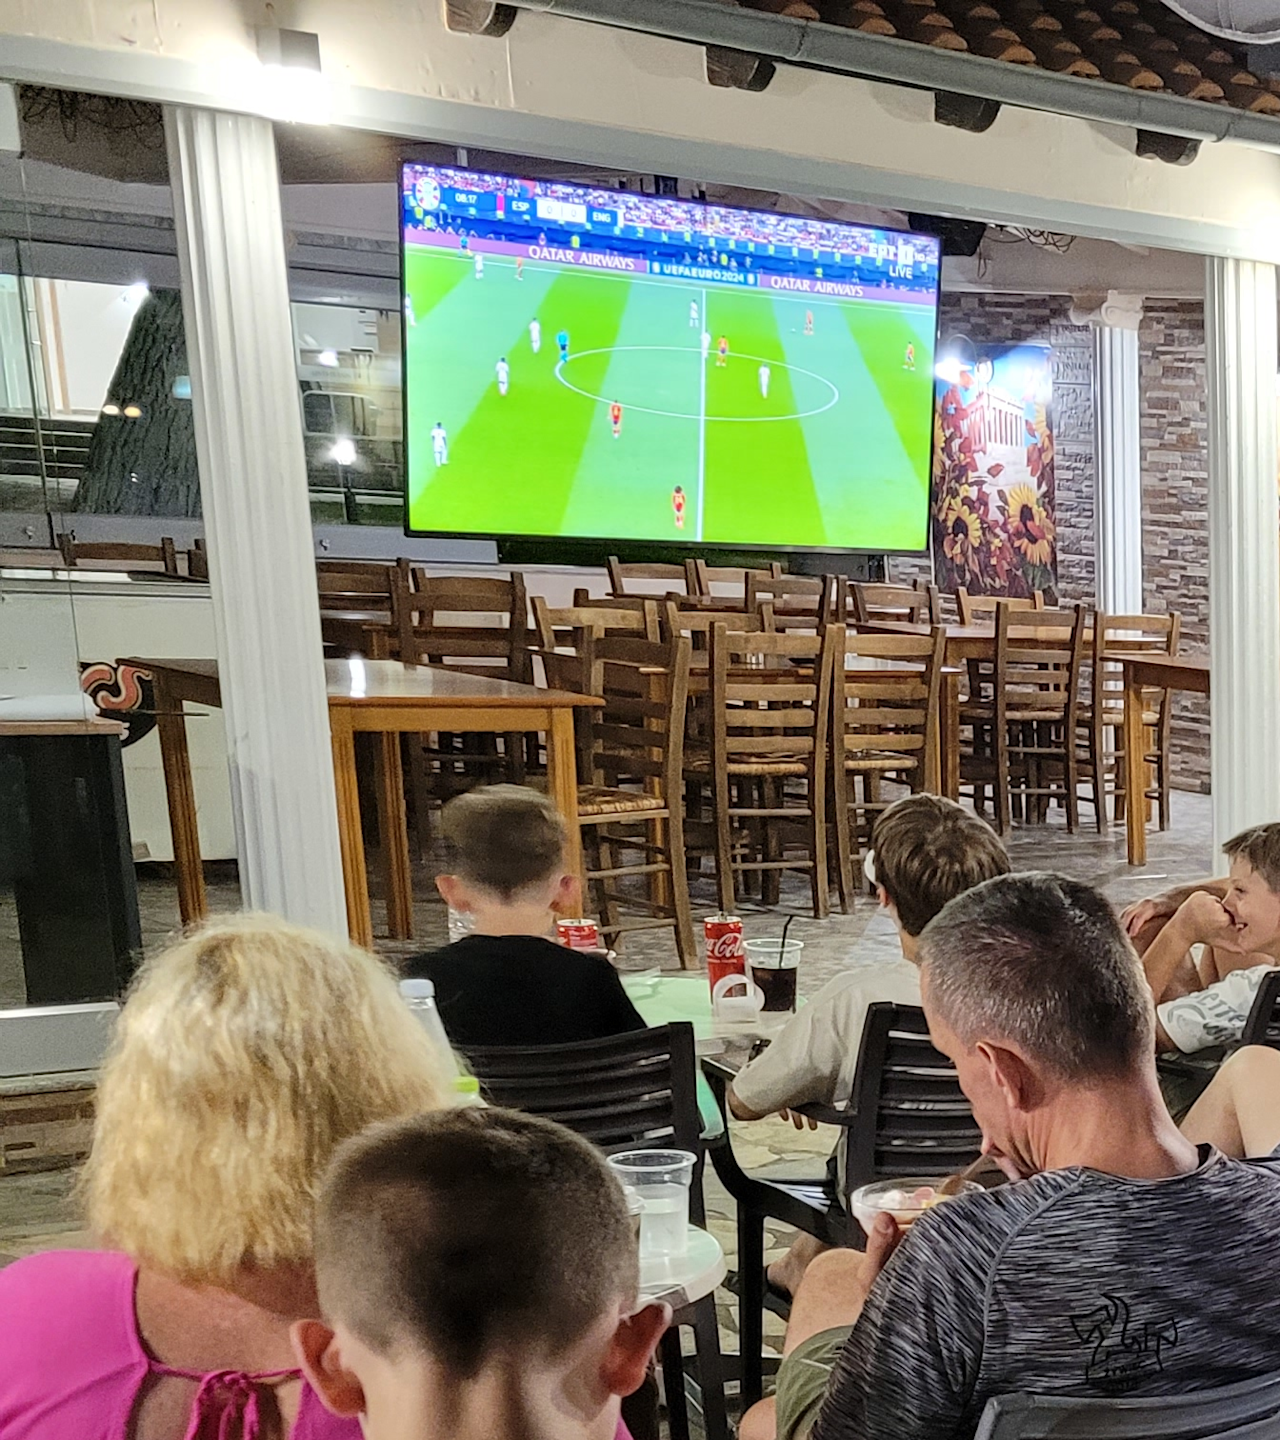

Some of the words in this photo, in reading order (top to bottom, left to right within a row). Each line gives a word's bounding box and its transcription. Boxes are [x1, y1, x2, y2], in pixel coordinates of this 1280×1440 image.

[511, 200, 530, 212] ESP
[592, 210, 611, 223] ENG
[528, 244, 575, 263] QATAR
[578, 251, 635, 270] AIRWAYS
[889, 264, 913, 280] LIVE
[770, 275, 810, 292] QATAR
[814, 280, 864, 297] AIRWAYS
